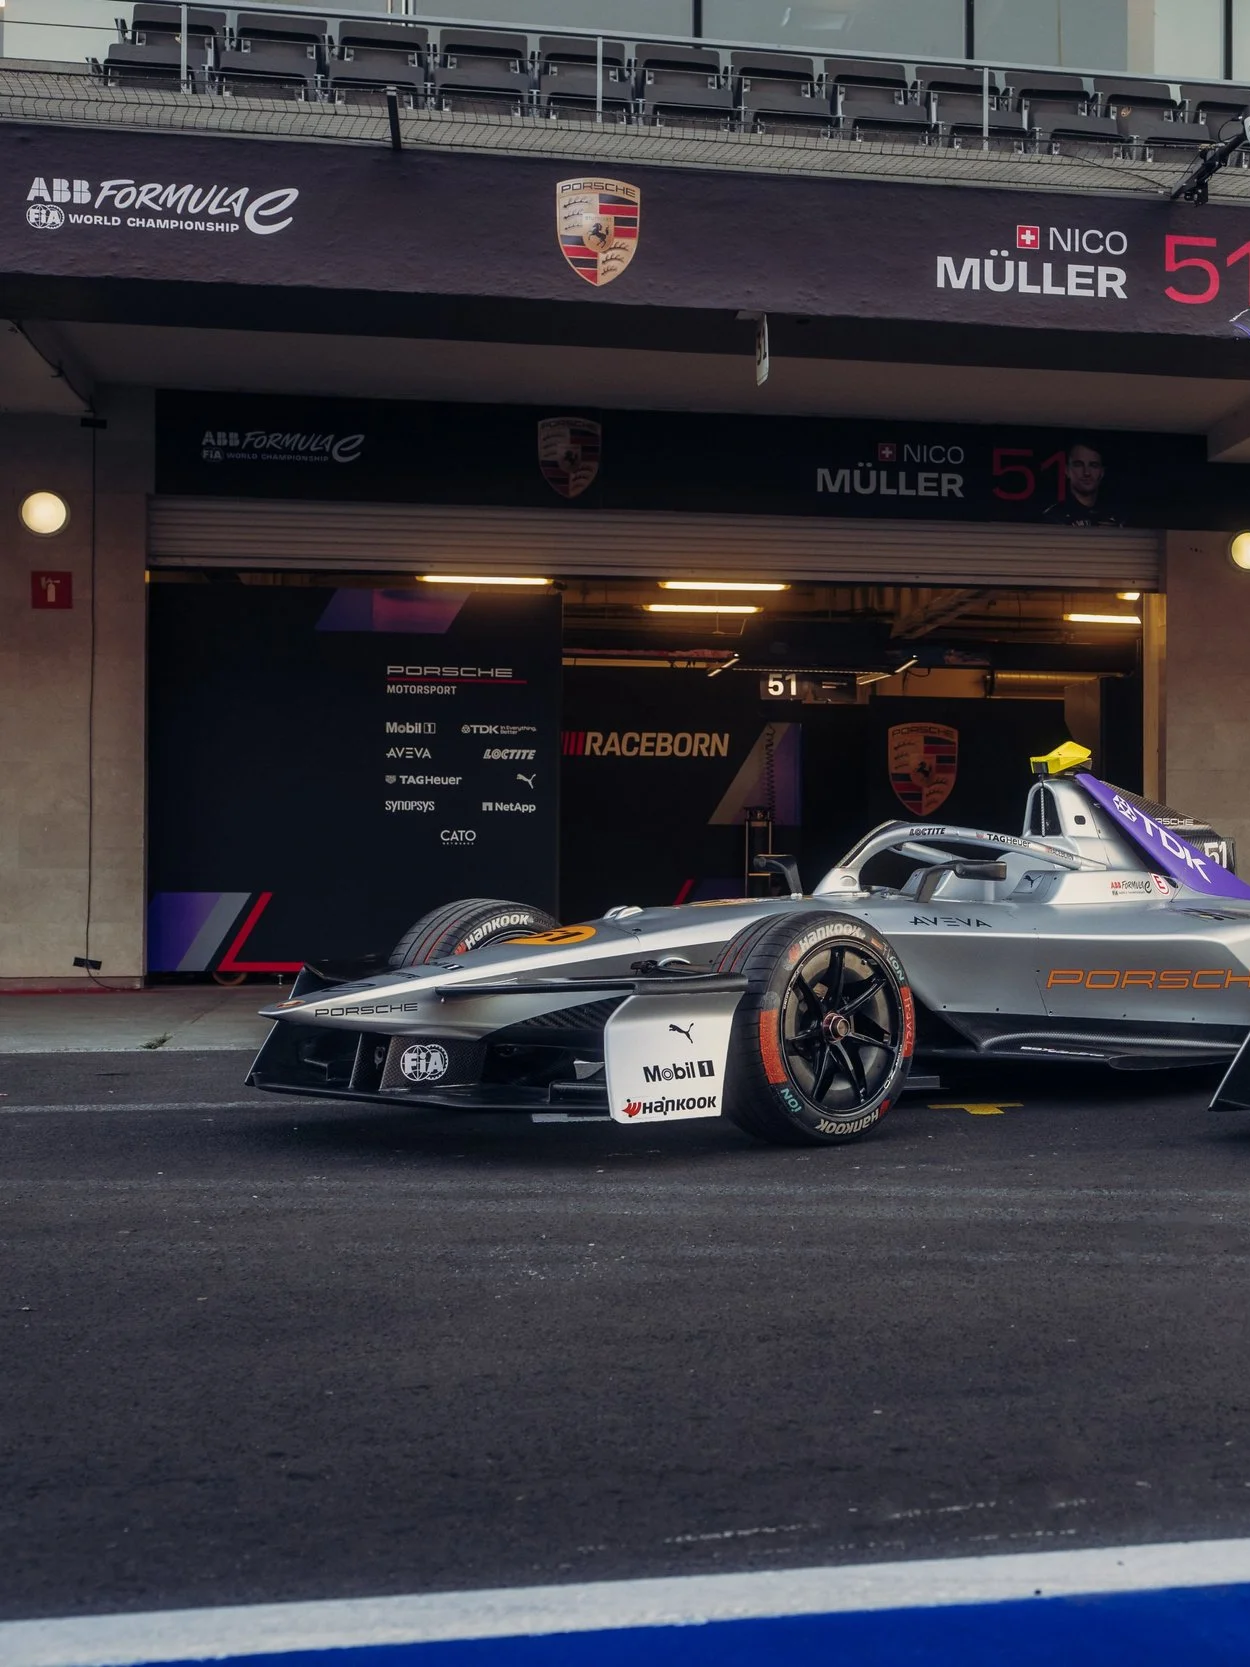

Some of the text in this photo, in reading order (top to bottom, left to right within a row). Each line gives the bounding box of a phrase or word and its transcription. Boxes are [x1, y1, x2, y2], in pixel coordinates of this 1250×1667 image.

[26, 177, 92, 204] ABB
[94, 179, 250, 218] FORMULA
[561, 182, 636, 198] PORSCHE
[68, 214, 121, 227] WORLD
[127, 217, 239, 233] CHAMPIONSHIP
[1049, 227, 1128, 255] NICO
[936, 249, 1128, 299] MÜLLER
[202, 431, 239, 446] ABB
[241, 431, 335, 452] FORMULA
[226, 452, 258, 461] WORLD
[261, 452, 329, 462] CHAMPIONSHIP
[904, 444, 965, 465] NICO
[816, 462, 965, 498] MÜLLER
[991, 447, 1067, 502] 51
[387, 665, 513, 678] PORSCHE
[387, 685, 457, 695] MOTORSPORT
[768, 674, 798, 697] 51
[386, 721, 436, 735] Mobil 1
[469, 724, 500, 735] TDK
[892, 724, 956, 740] PORSCHE
[585, 732, 731, 758] RACEBORN
[386, 748, 432, 759] AVEVA
[483, 749, 536, 760] LOCTITE
[385, 800, 435, 813] SYNOPSYS
[495, 802, 537, 813] NetApp
[440, 829, 477, 842] CATO
[910, 828, 946, 836] LOCTITE
[1133, 807, 1211, 883] TDK
[1203, 841, 1228, 869] 51
[910, 916, 992, 928] AVEVA
[314, 1003, 419, 1017] PORSCHE
[643, 1060, 715, 1083] Mobil 1
